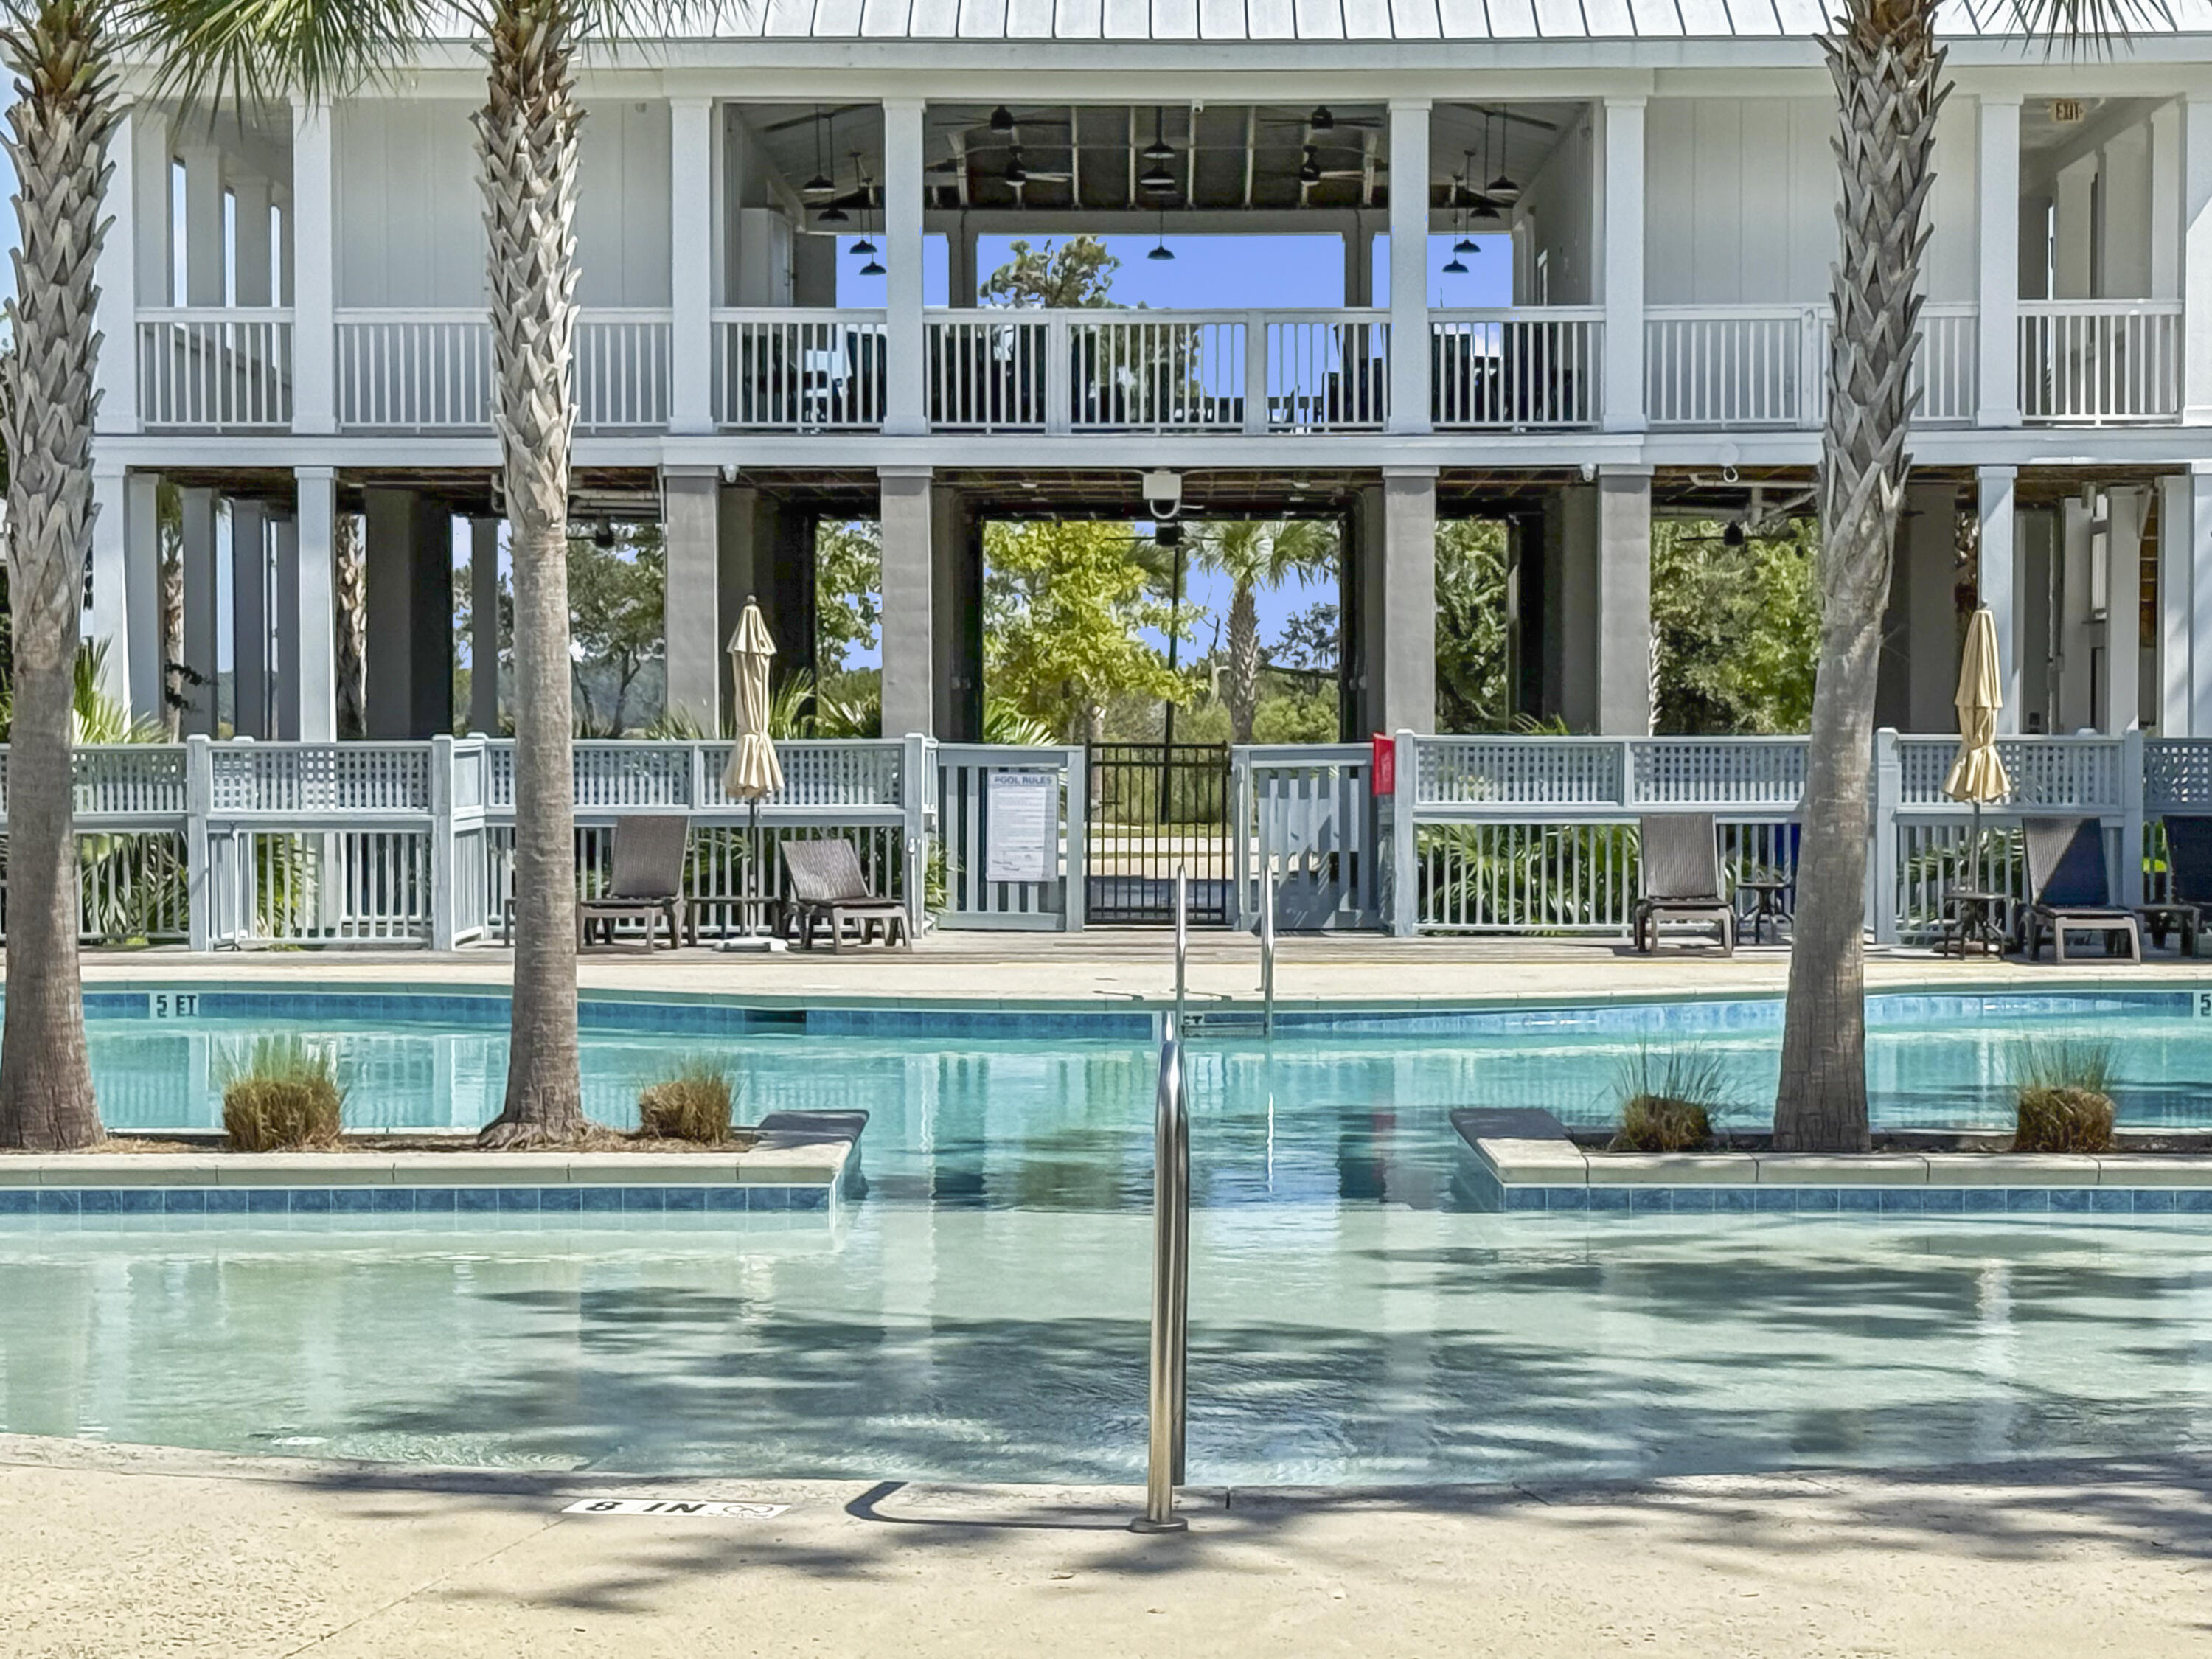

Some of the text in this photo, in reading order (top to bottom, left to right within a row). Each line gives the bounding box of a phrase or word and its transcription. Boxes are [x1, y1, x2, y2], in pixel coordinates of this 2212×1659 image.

[2056, 102, 2079, 121] EXIT
[995, 776, 1053, 785] POOL RULES
[585, 1500, 709, 1513] 8 IN
